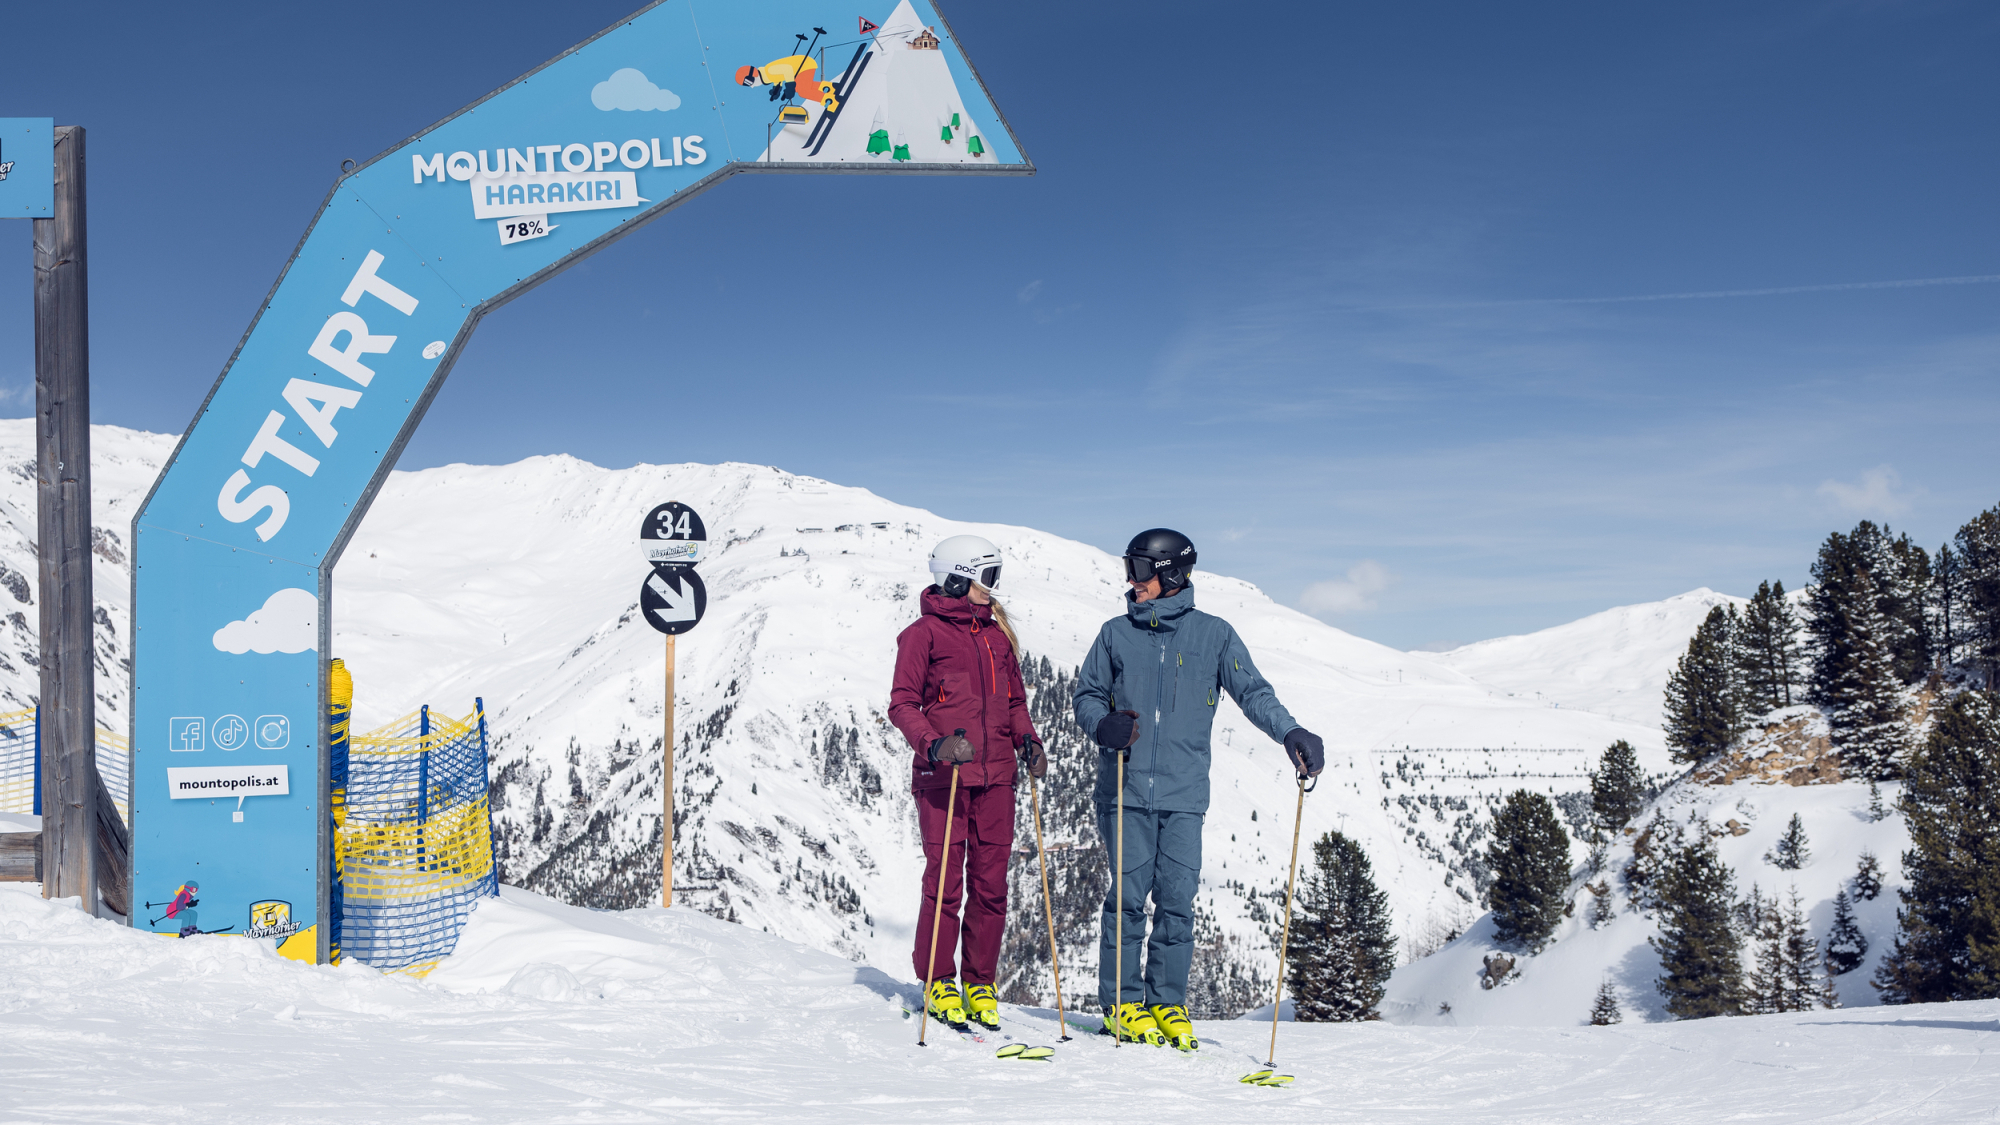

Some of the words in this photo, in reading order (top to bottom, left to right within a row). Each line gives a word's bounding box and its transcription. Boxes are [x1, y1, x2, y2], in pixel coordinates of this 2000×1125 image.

[412, 135, 707, 184] MOUNTOPOLIS
[485, 179, 622, 206] HARAKIRI
[505, 219, 543, 239] 78%
[217, 249, 419, 543] START
[656, 510, 692, 540] 34
[179, 775, 279, 791] mountopolis.at
[242, 921, 301, 939] Mayrhofner
